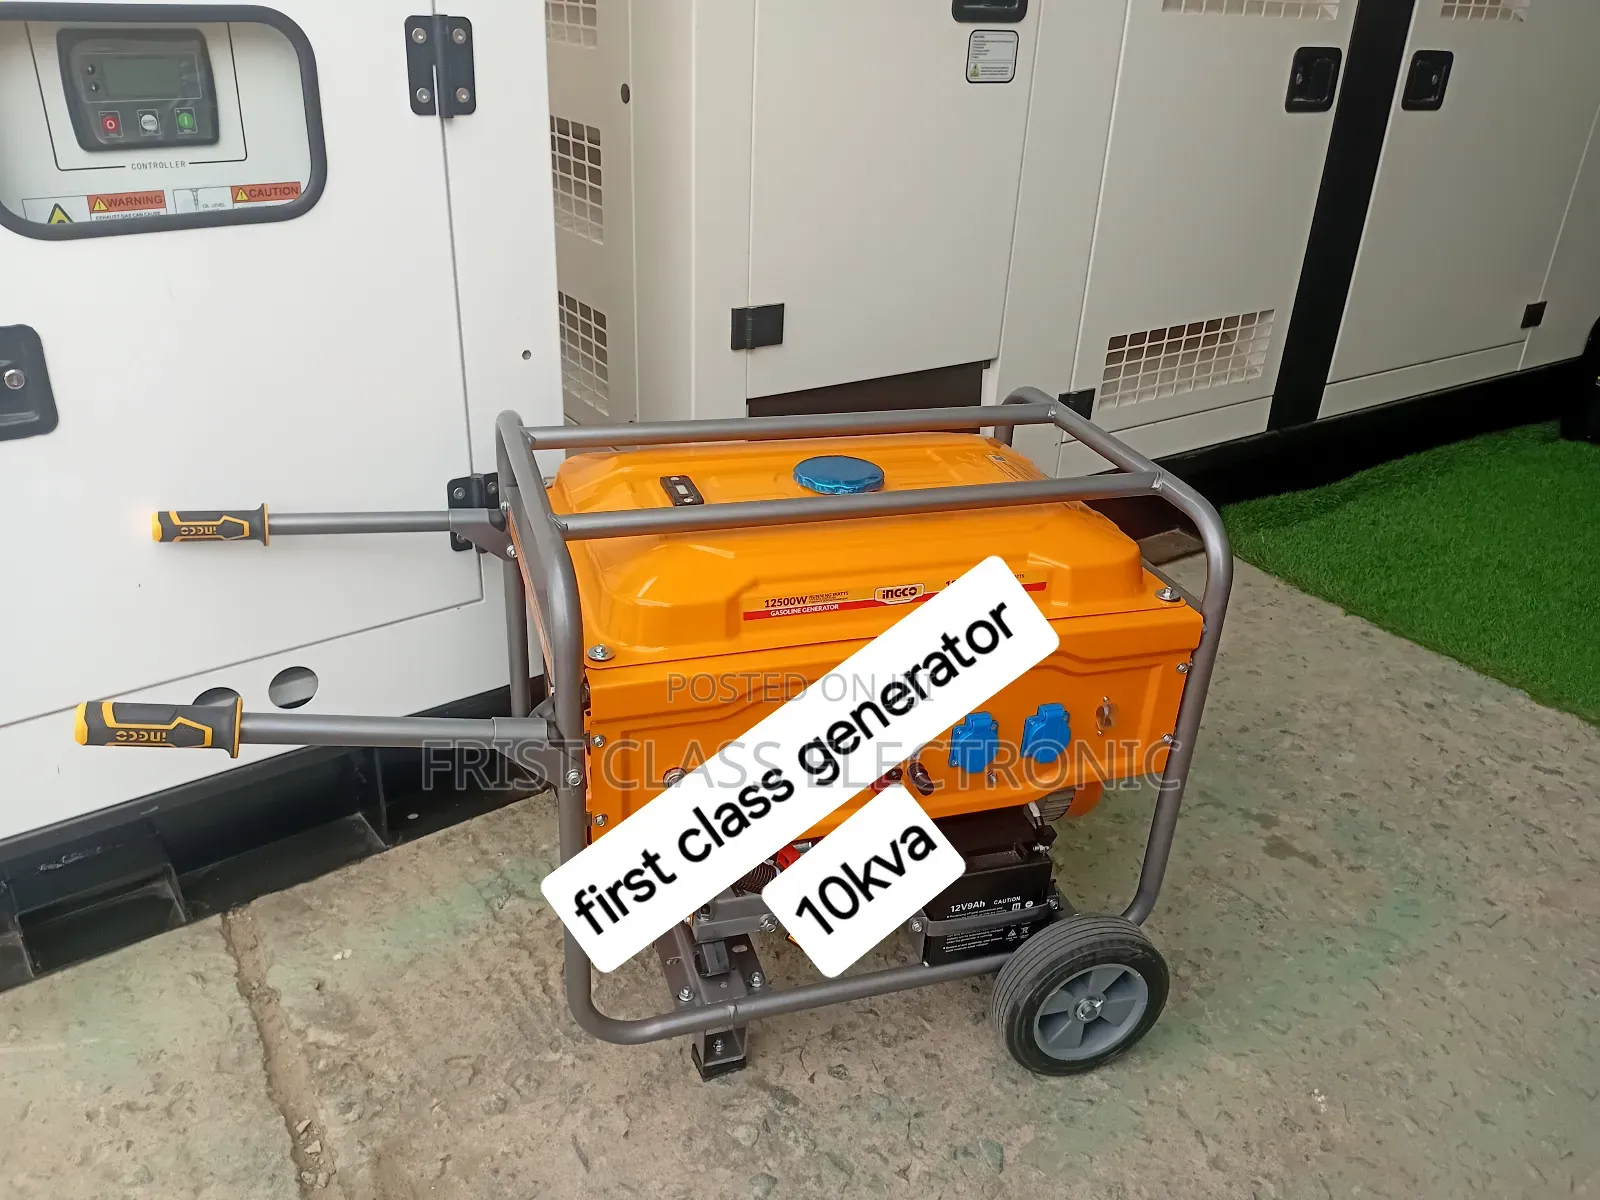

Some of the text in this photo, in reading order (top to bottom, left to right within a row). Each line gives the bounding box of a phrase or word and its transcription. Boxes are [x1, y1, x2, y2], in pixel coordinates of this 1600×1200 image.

[131, 160, 186, 171] CONTROLLER
[248, 186, 300, 199] CAUTION
[106, 194, 163, 208] WARNING
[764, 595, 808, 608] 12500W
[770, 604, 839, 617] GASOLINE GENERATOR
[950, 900, 986, 913] 12V9Ah
[993, 895, 1021, 906] CAUTION
